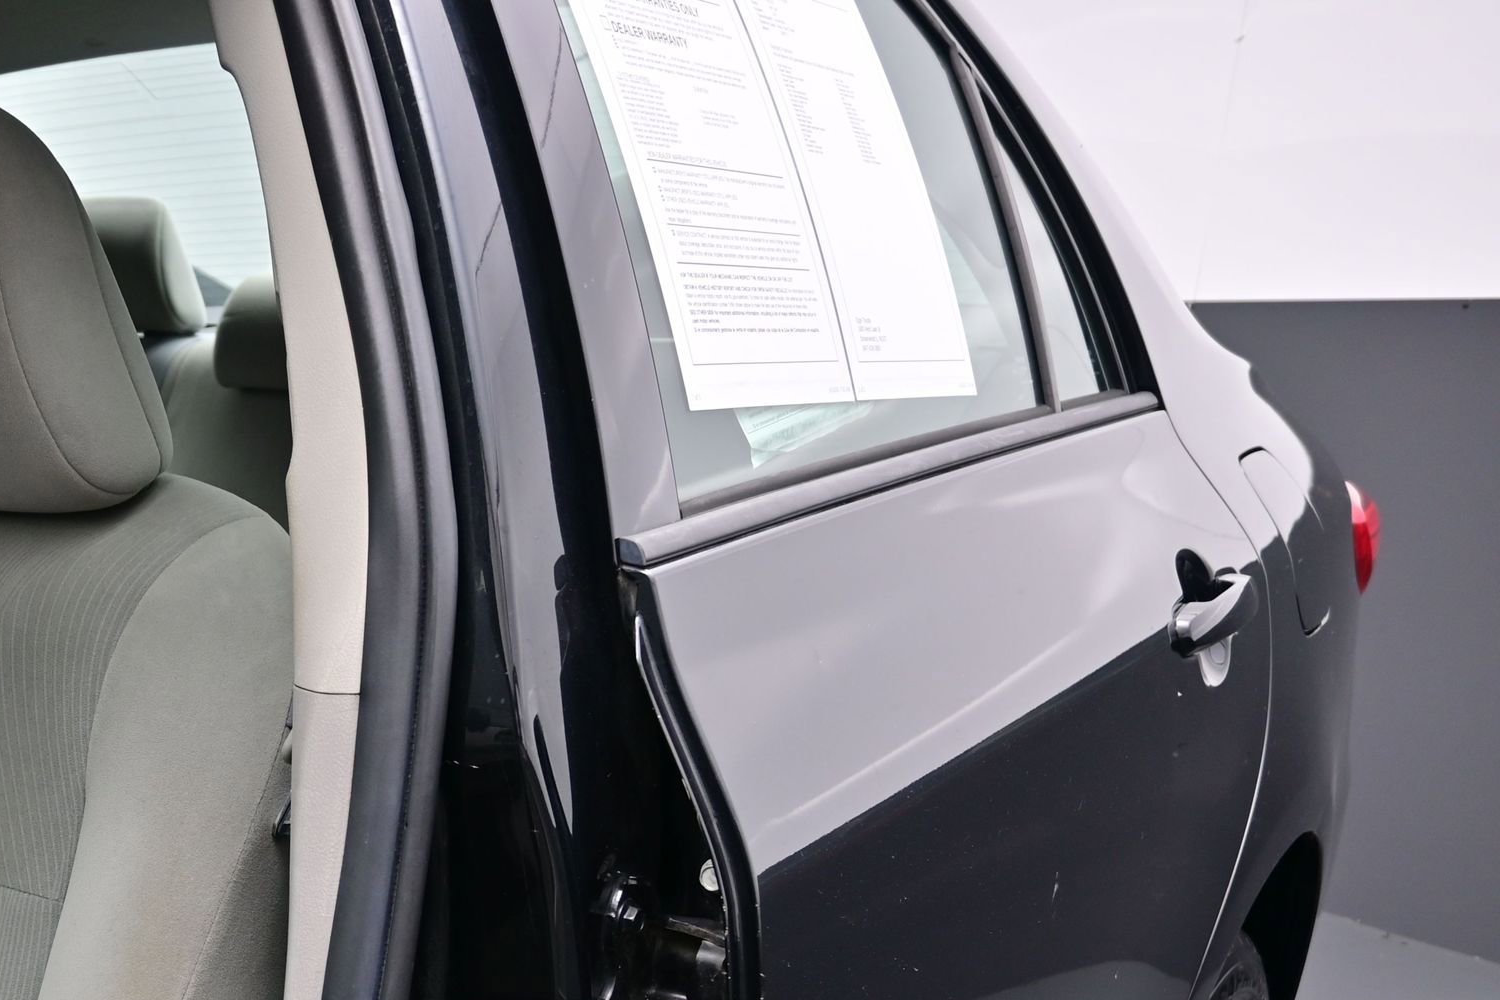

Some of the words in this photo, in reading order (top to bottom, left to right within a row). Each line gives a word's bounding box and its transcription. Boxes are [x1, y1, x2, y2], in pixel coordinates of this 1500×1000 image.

[680, 3, 699, 17] ONLY
[611, 21, 645, 39] DEALER
[646, 28, 688, 48] WARRANTY
